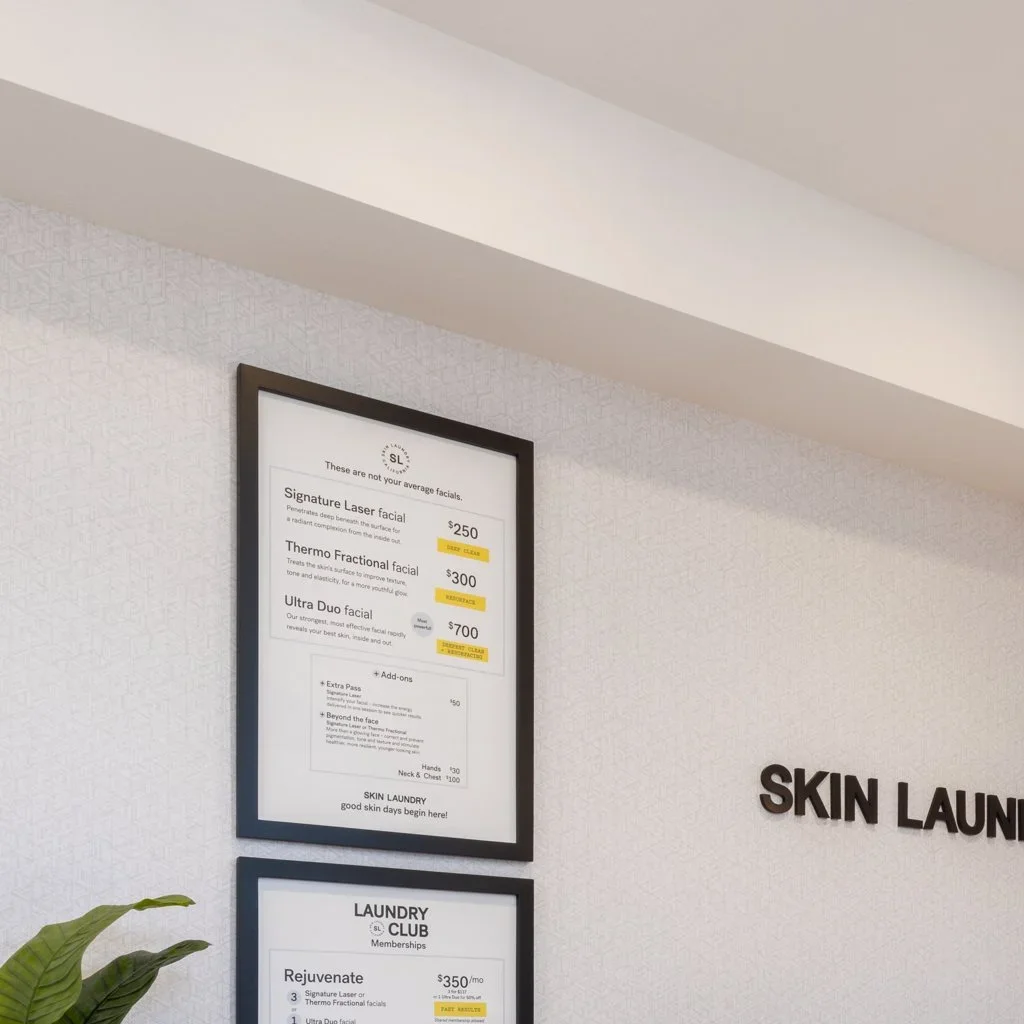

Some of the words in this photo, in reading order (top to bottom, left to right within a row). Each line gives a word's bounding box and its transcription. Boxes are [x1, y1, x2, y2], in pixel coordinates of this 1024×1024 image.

[389, 453, 403, 465] SL
[324, 460, 350, 474] These
[352, 469, 366, 478] are
[368, 473, 382, 482] not
[383, 477, 402, 486] your
[403, 481, 434, 494] average
[436, 487, 462, 501] facials.
[284, 487, 341, 509] Signature
[344, 500, 375, 516] Laser
[378, 507, 405, 523] facial
[286, 504, 318, 516] Penetrates
[319, 512, 334, 520] deep
[335, 515, 359, 524] beneath
[370, 524, 391, 532] surface
[291, 518, 312, 526] radiant
[314, 522, 347, 533] complexion
[348, 528, 362, 536] from
[373, 533, 390, 542] inside
[448, 520, 478, 539] $250
[285, 540, 331, 559] Thermo
[334, 549, 389, 570] Fractional
[392, 561, 418, 576] facial
[287, 557, 305, 566] Treats
[334, 567, 355, 576] surface
[363, 572, 385, 582] improve
[446, 569, 476, 588] $300
[285, 595, 313, 609] Ultra
[317, 600, 341, 614] Duo
[344, 605, 372, 619] facial
[346, 622, 370, 632] effective
[387, 630, 406, 639] rapidly
[352, 634, 369, 642] inside
[448, 621, 478, 639] $700
[380, 671, 412, 682] Add-ons
[326, 680, 344, 689] Extra
[345, 683, 361, 692] Pass
[326, 711, 351, 721] Beyond
[364, 717, 378, 725] face
[421, 764, 441, 772] Hands
[423, 772, 441, 780] Chest
[446, 775, 460, 783] $100
[364, 791, 384, 800] SKIN
[387, 794, 426, 805] LAUNDRY
[759, 763, 879, 825] SKIN
[340, 802, 361, 810] good
[364, 803, 381, 812] skin
[382, 805, 402, 815] days
[404, 807, 426, 818] begin
[428, 809, 447, 818] here!
[354, 903, 428, 920] LAUNDRY
[388, 922, 428, 937] CLUB
[371, 939, 426, 950] Memberships
[284, 968, 363, 986] Rejuvenate
[437, 974, 483, 988] $350/mo
[304, 989, 337, 998] Signature
